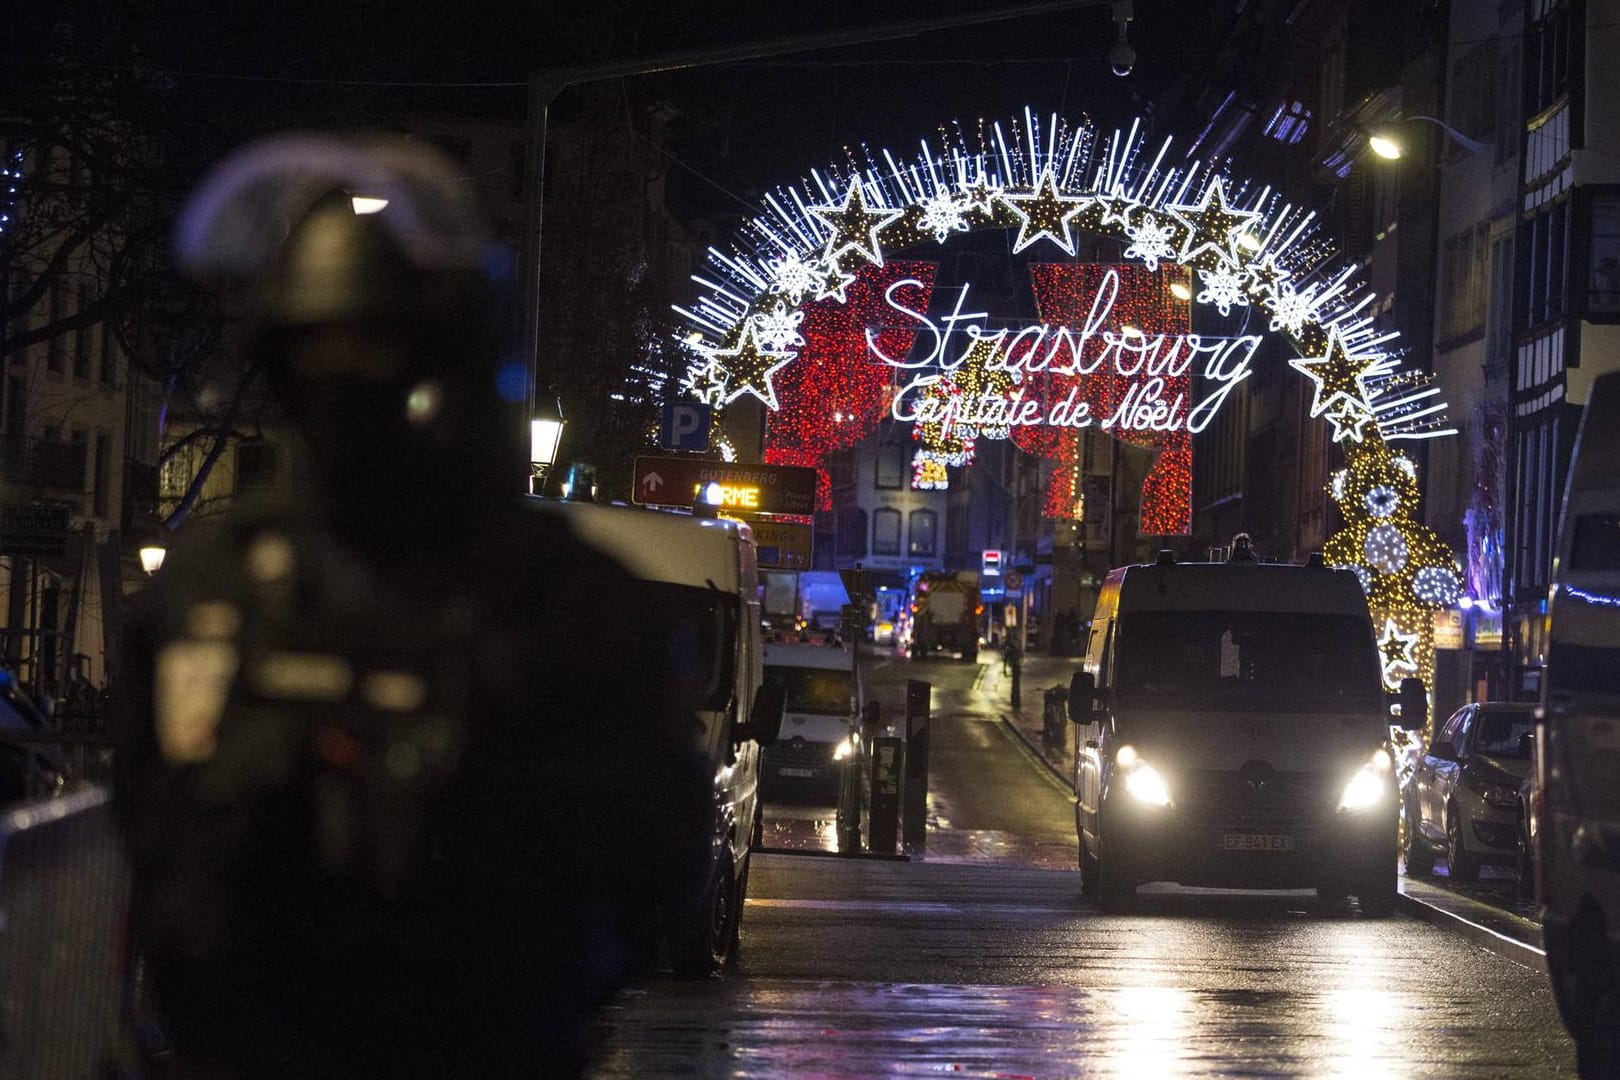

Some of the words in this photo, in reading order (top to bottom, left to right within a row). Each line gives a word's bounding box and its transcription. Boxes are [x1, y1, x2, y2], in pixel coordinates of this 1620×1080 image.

[865, 269, 1263, 433] Strasbourg
[671, 406, 699, 446] P
[892, 374, 1042, 440] Capitale
[1050, 387, 1091, 427] de
[1103, 378, 1182, 431] Noël
[700, 469, 778, 485] GUTENBERG
